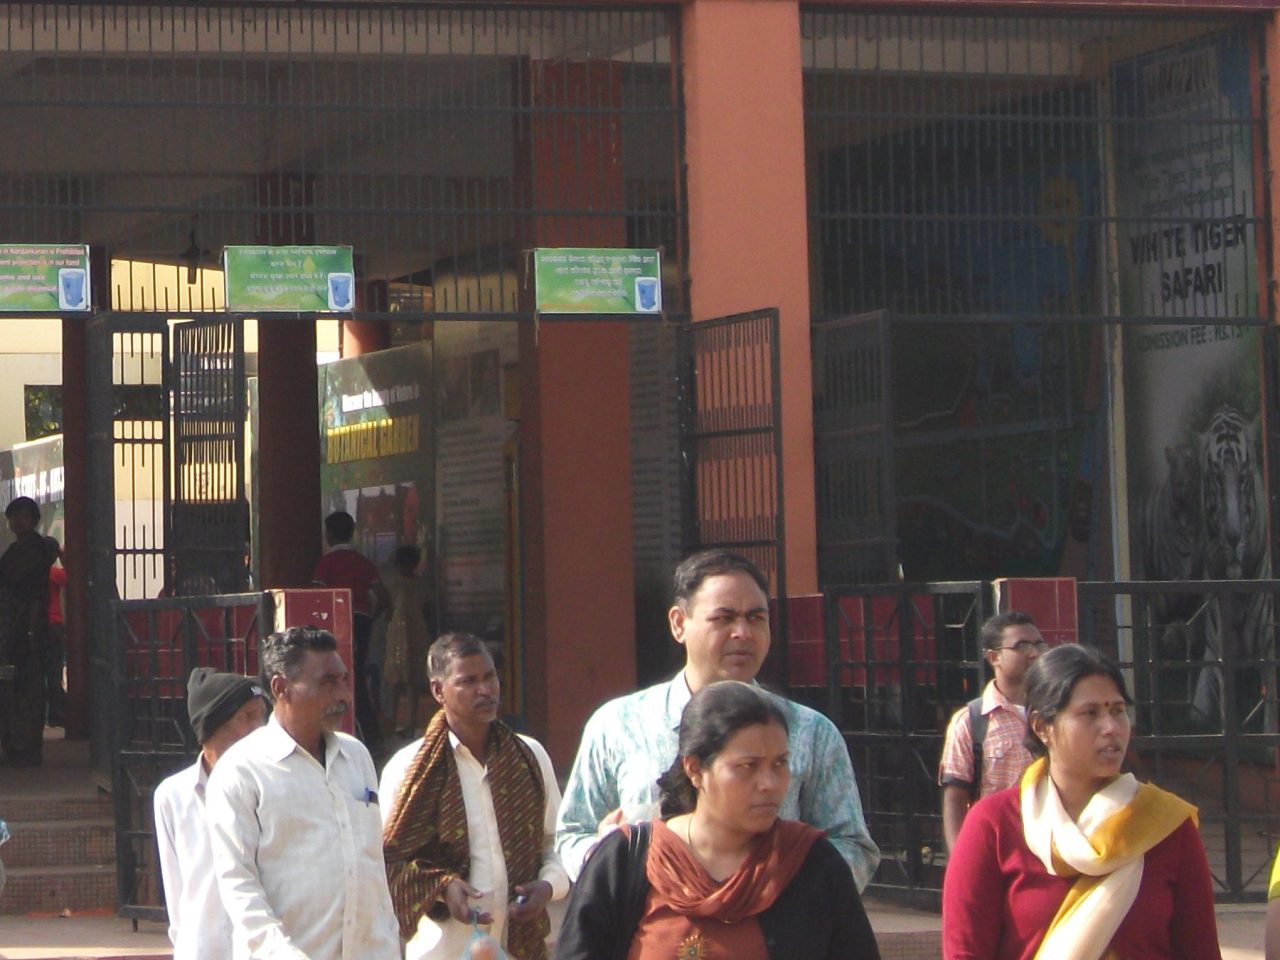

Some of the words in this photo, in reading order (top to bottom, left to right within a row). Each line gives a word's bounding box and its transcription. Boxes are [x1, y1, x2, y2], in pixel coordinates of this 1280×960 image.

[1130, 226, 1186, 265] WHTE
[1194, 214, 1246, 254] TIGER
[1161, 262, 1223, 303] SAFARI
